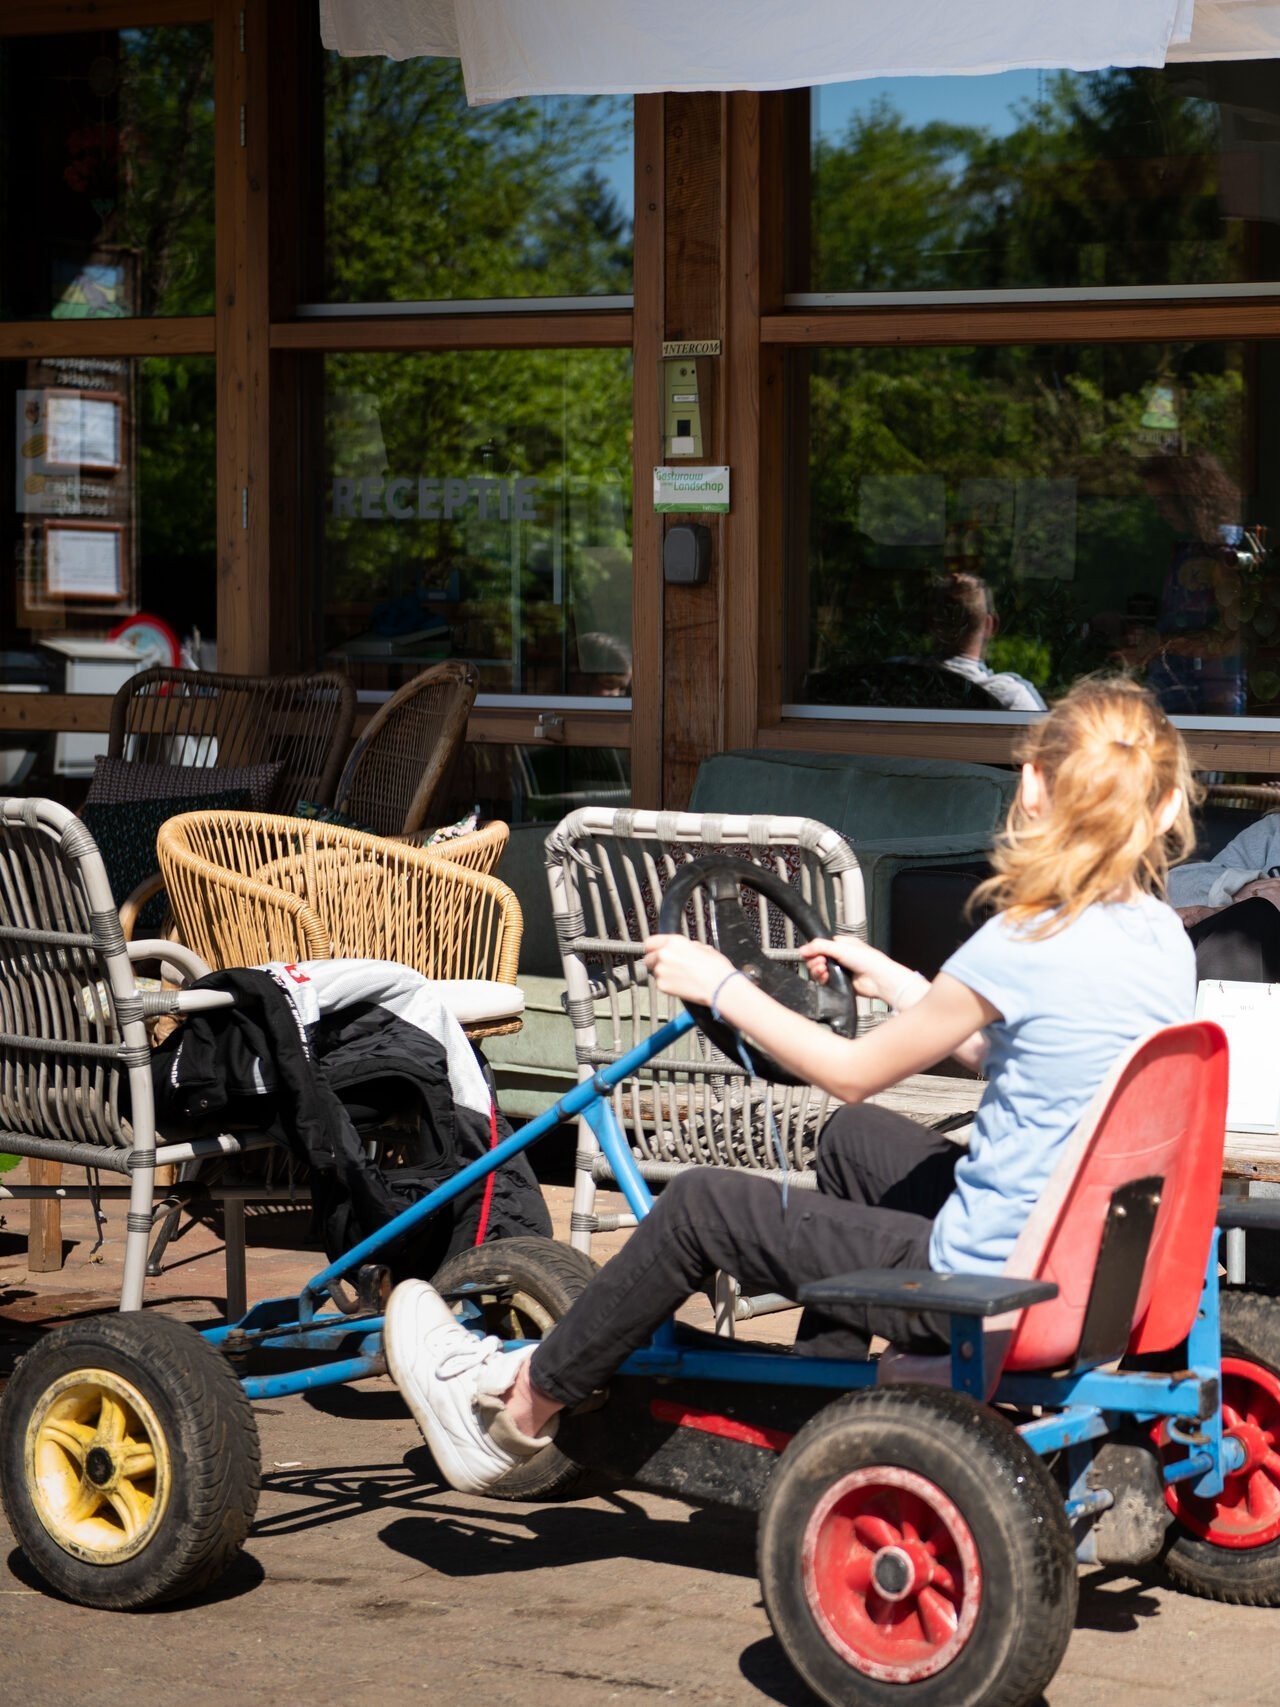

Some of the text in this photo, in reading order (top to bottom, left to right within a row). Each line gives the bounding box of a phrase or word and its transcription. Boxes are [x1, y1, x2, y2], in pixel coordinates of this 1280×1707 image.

[664, 342, 720, 355] INTERCOM
[673, 480, 724, 493] Landschap
[332, 476, 537, 520] RECEPTIE
